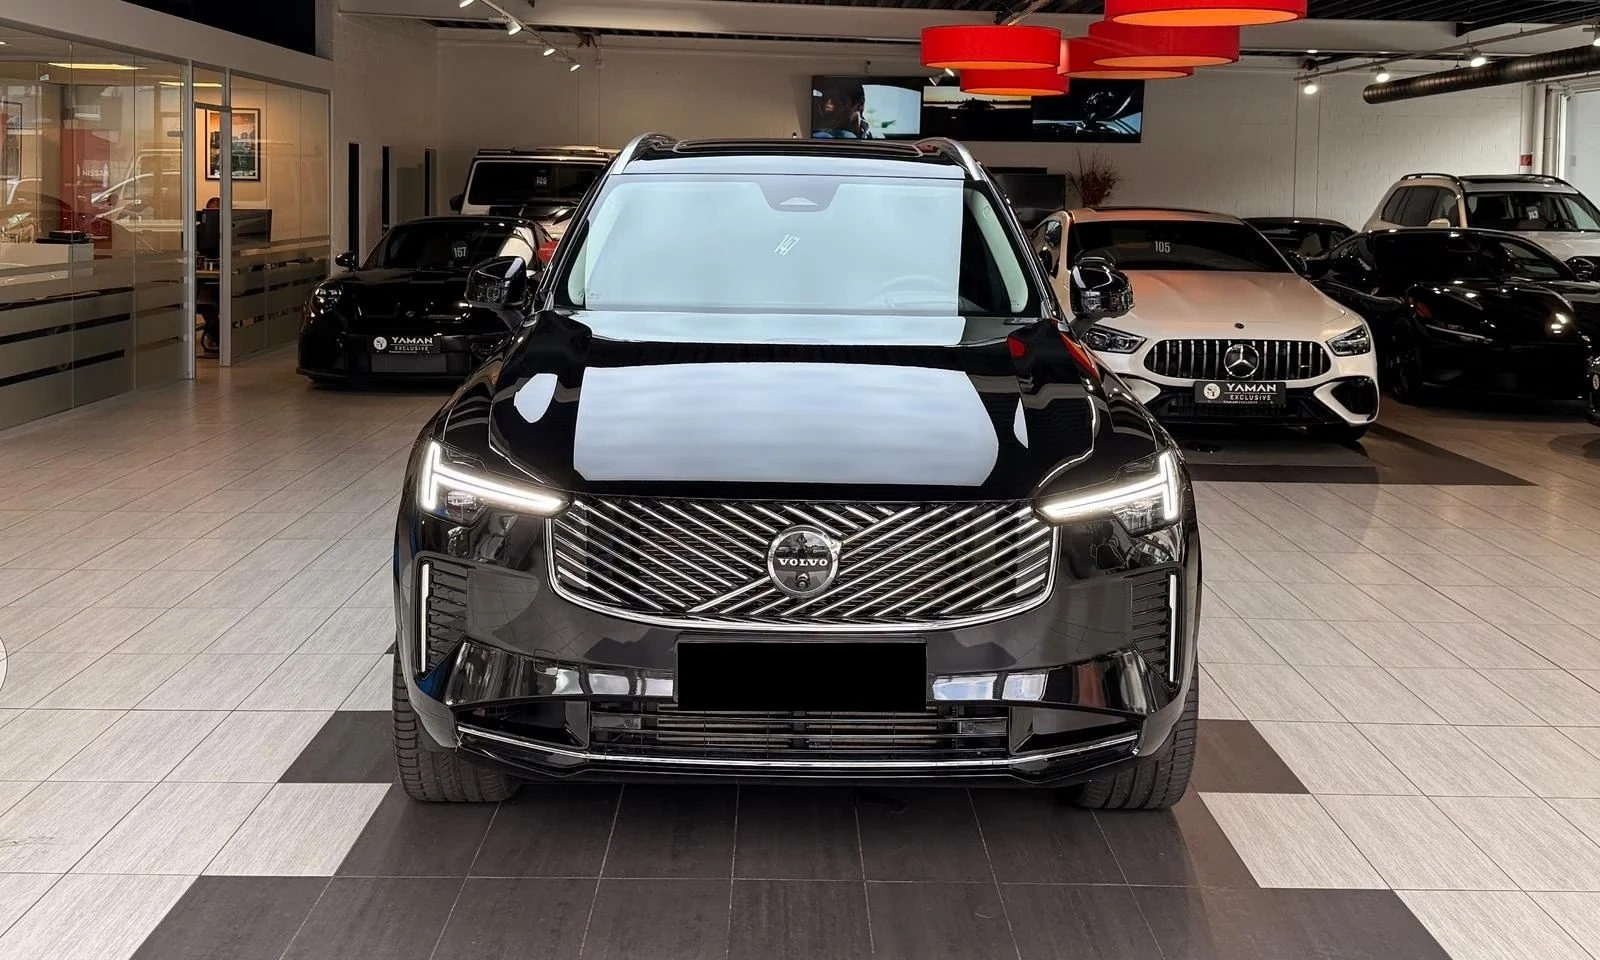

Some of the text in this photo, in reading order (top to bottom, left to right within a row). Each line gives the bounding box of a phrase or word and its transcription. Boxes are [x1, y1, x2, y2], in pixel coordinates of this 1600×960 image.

[1154, 240, 1171, 253] 105
[453, 246, 467, 258] 167
[391, 336, 433, 344] YAMAN
[1226, 383, 1277, 392] YAMAN
[777, 558, 828, 567] VOLVO
